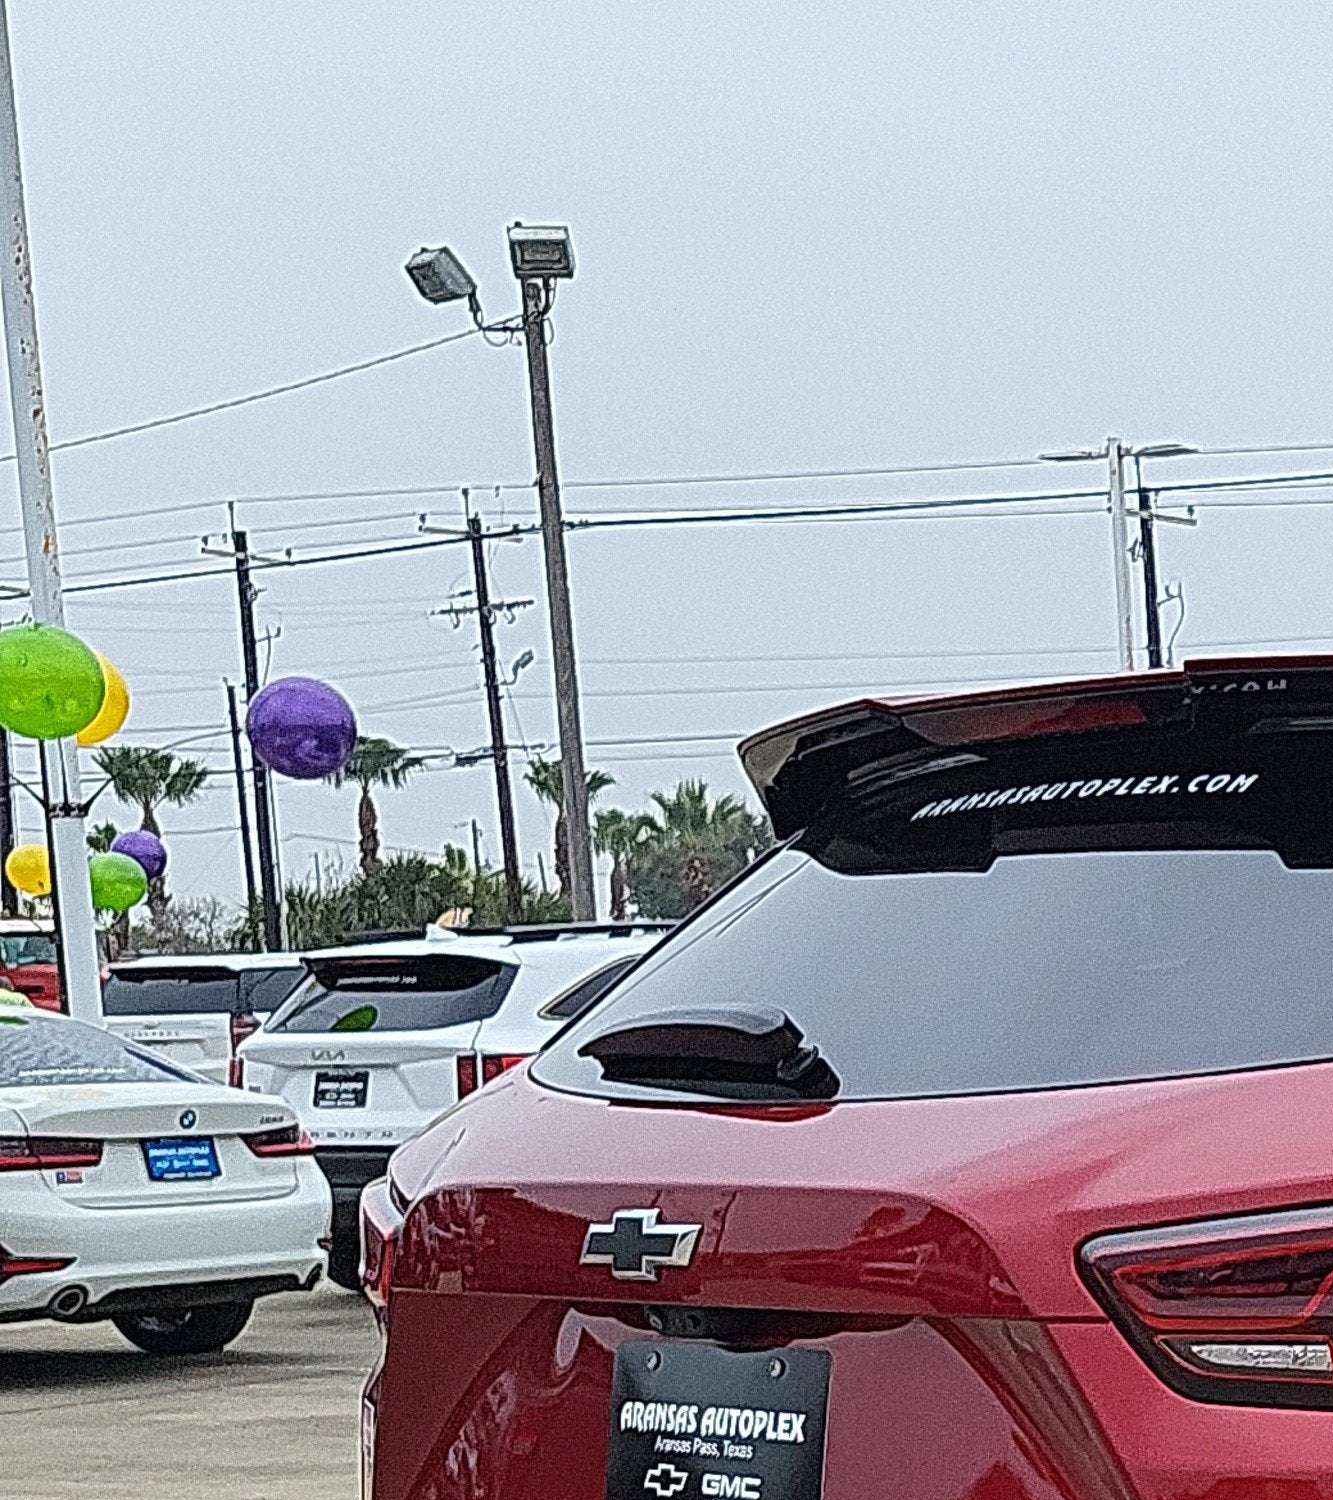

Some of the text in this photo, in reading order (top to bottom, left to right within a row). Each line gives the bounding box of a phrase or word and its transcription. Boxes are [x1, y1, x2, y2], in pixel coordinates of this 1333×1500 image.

[910, 773, 1259, 823] ARANSASAUTOPLEX.COM
[620, 1401, 806, 1443] ARANSAS AUTOPLEX
[653, 1435, 753, 1460] Aransas Pass, Texas
[701, 1473, 762, 1500] GMC
